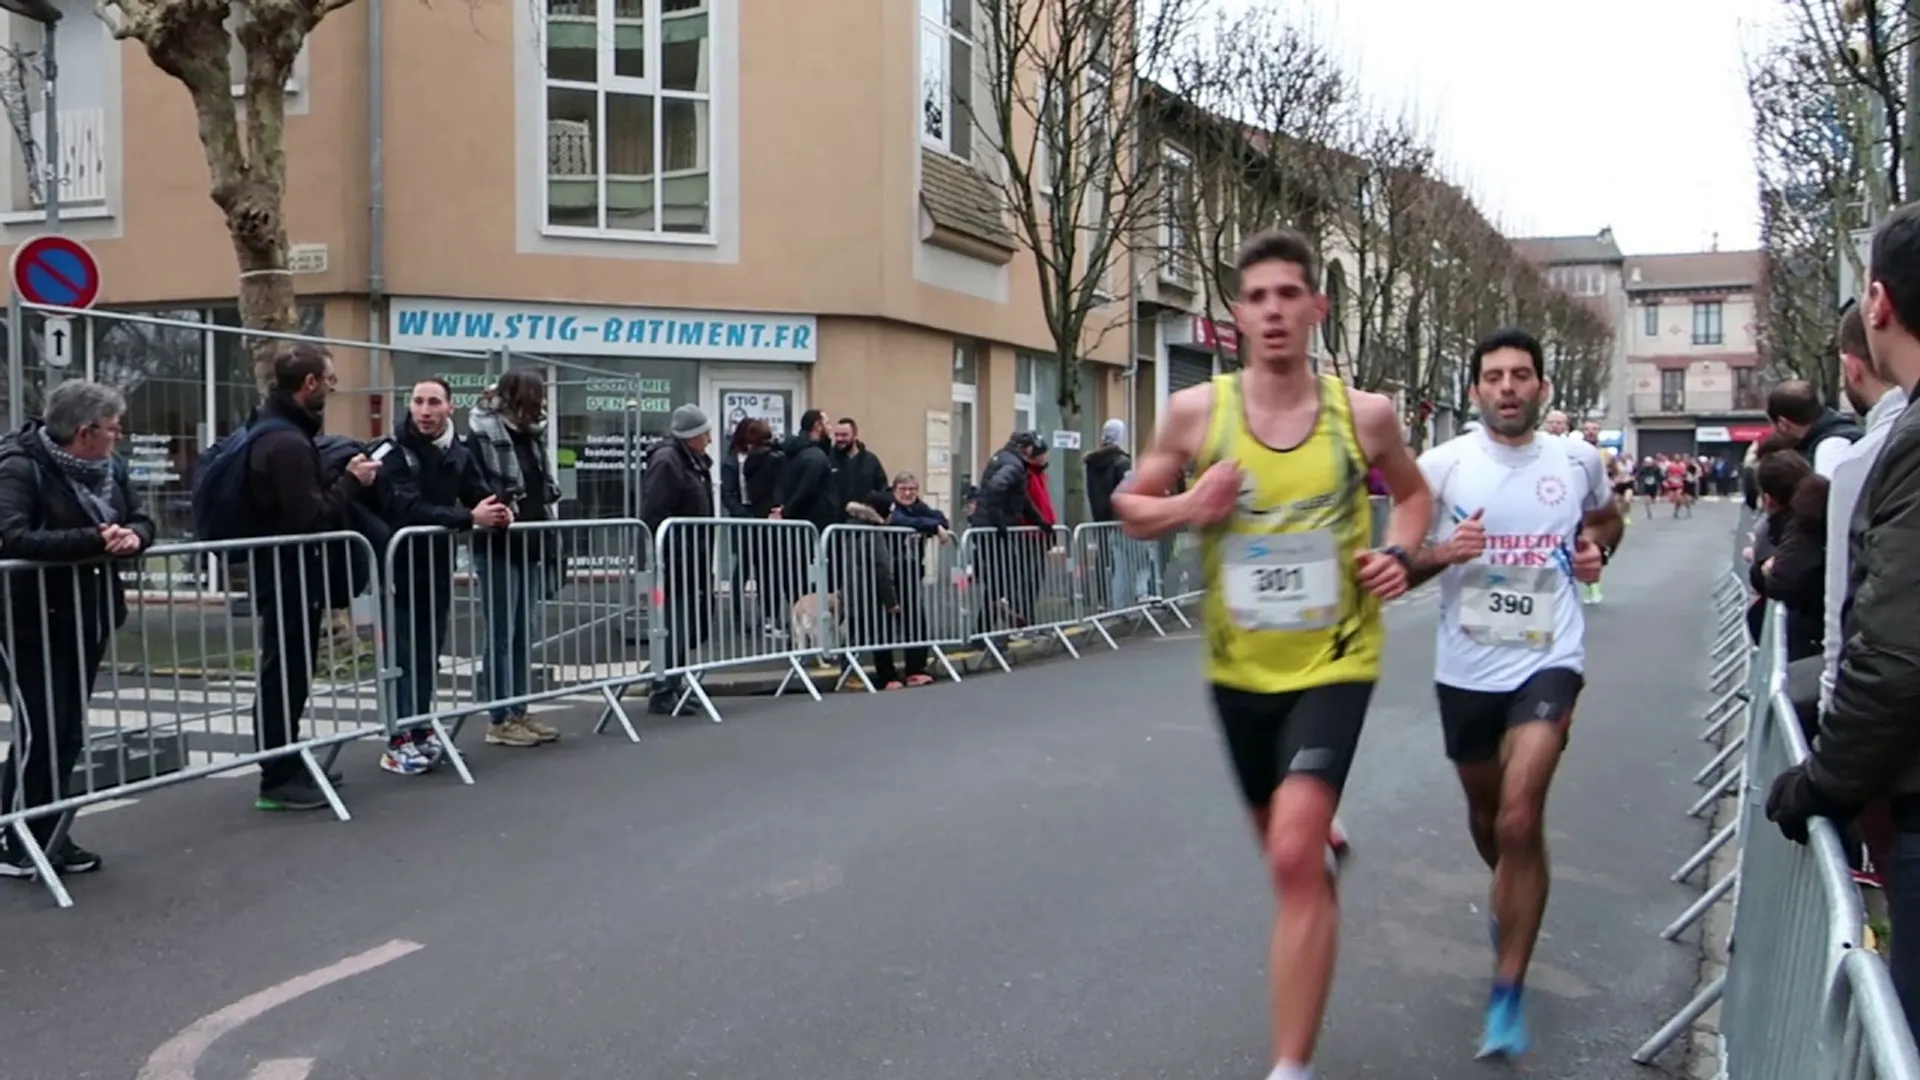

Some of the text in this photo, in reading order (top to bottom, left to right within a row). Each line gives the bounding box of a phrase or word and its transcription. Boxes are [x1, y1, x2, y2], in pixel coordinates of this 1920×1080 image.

[398, 310, 813, 350] WWW.STIG-BATIMENT.FR
[586, 396, 671, 412] D'ENGIE
[727, 395, 758, 407] STIG
[587, 435, 630, 444] Isolatio
[574, 461, 629, 470] Menuiseri
[1486, 534, 1562, 549] THLETIC
[1251, 567, 1304, 592] 301
[1488, 592, 1534, 616] 390
